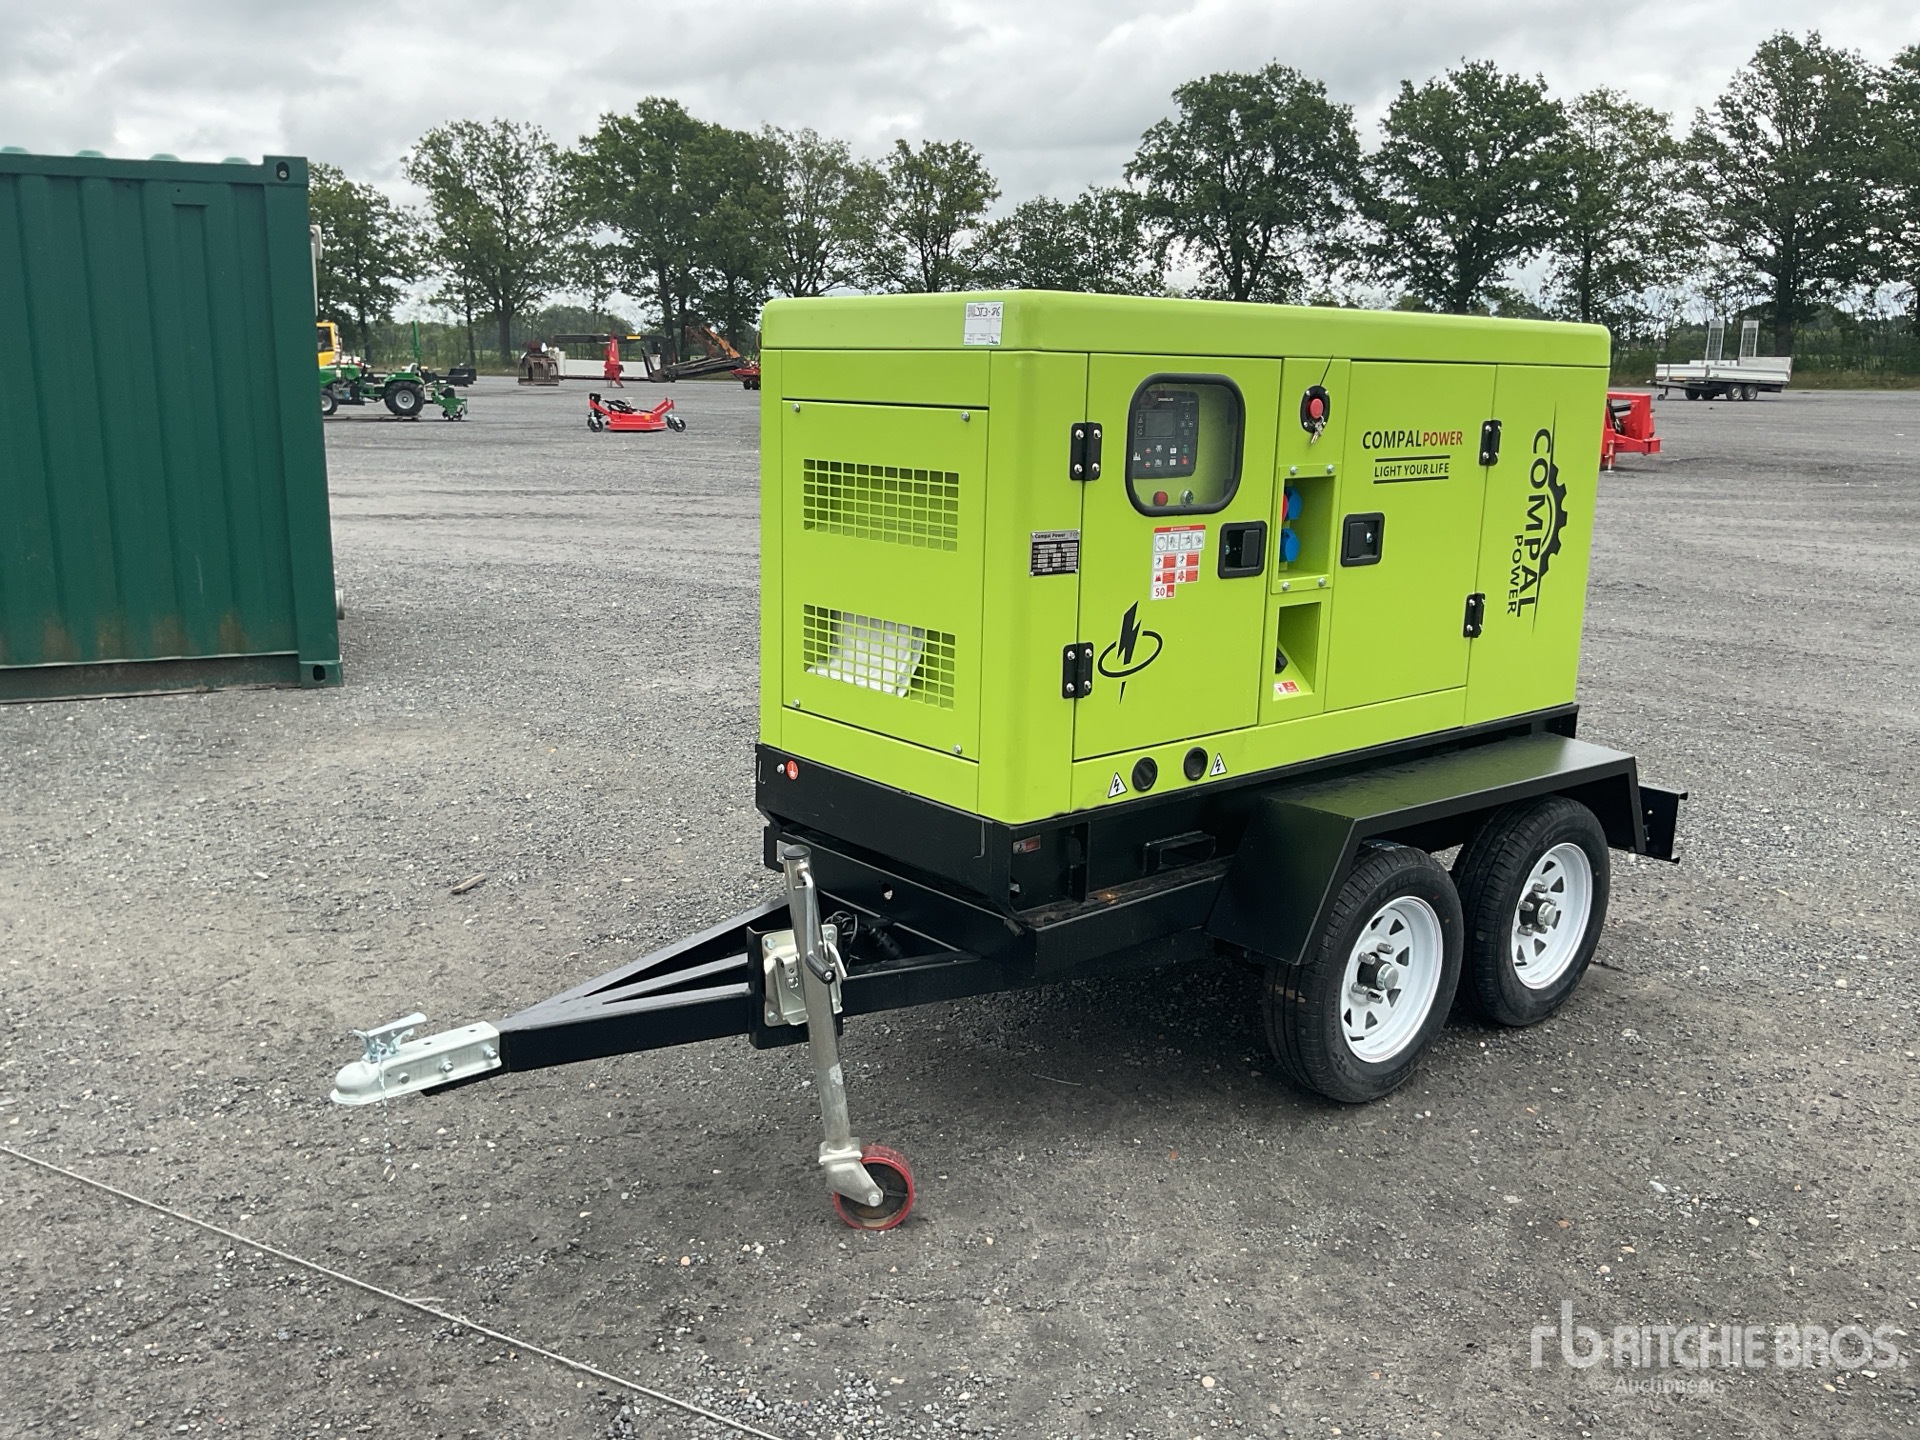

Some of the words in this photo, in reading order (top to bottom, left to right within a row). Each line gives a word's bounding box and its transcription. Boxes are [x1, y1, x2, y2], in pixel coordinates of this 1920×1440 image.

[1374, 466, 1402, 477] LIGHT
[1404, 464, 1429, 476] YOUR
[1430, 462, 1449, 474] LIFE
[1516, 428, 1551, 617] COMPAL
[1155, 587, 1165, 597] 50
[1507, 534, 1523, 614] POWER
